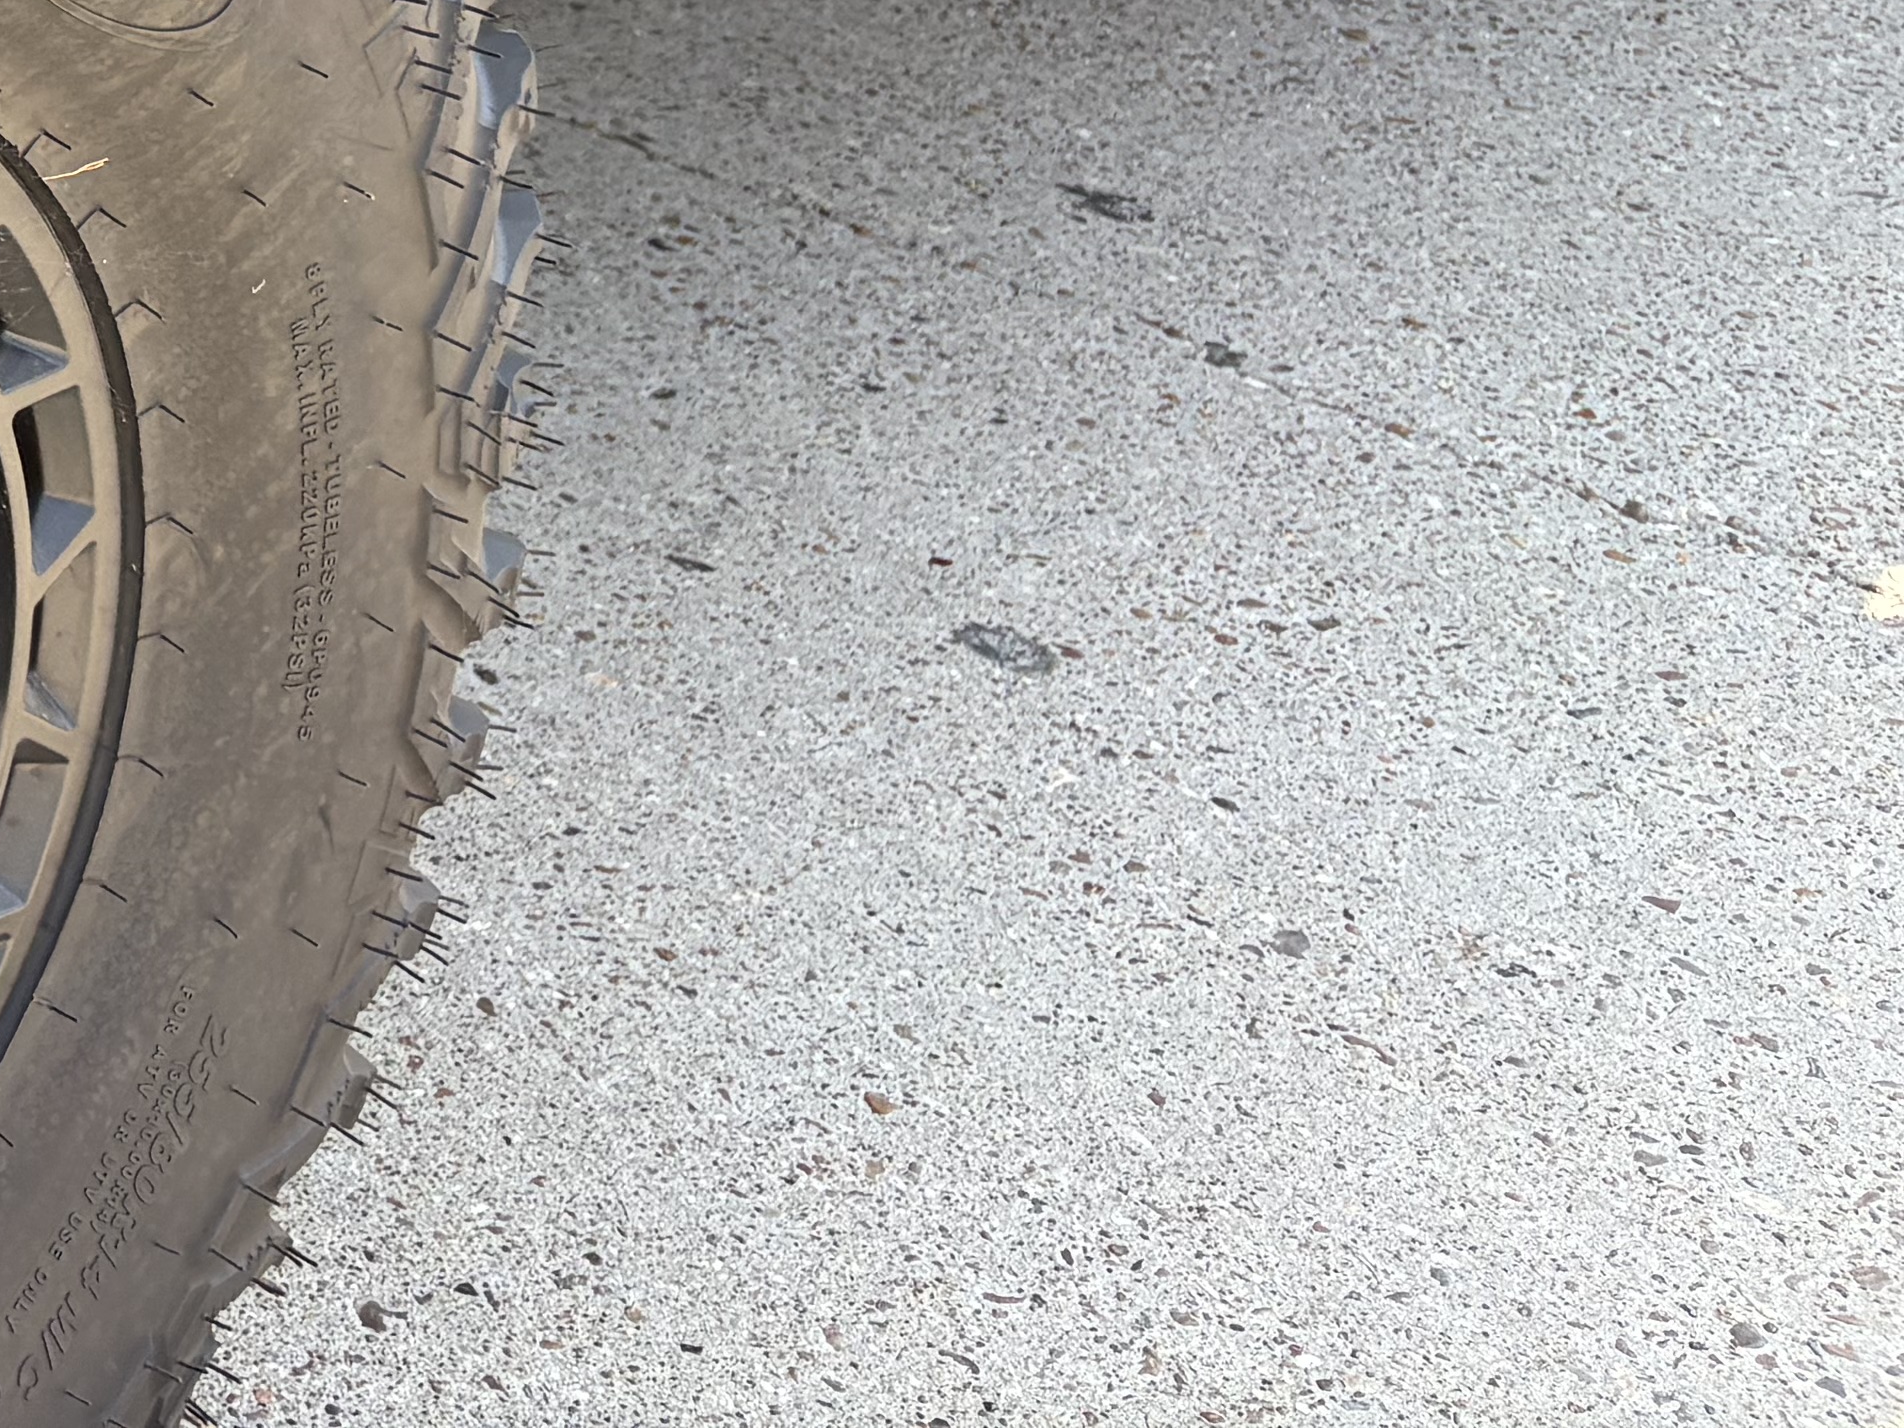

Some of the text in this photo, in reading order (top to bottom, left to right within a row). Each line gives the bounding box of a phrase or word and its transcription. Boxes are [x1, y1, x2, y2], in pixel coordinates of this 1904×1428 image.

[288, 311, 315, 394] MAX.
[316, 333, 341, 416] RATED
[297, 386, 320, 469] INFL.
[312, 449, 345, 610] TUBELESS
[281, 582, 316, 695] (32PSI)
[161, 984, 197, 1036] FOR
[131, 1044, 171, 1101] ATV
[81, 1014, 230, 1300] 255/80R14
[110, 1107, 139, 1145] OR
[78, 1151, 117, 1205] UTV
[46, 1209, 85, 1262] USE
